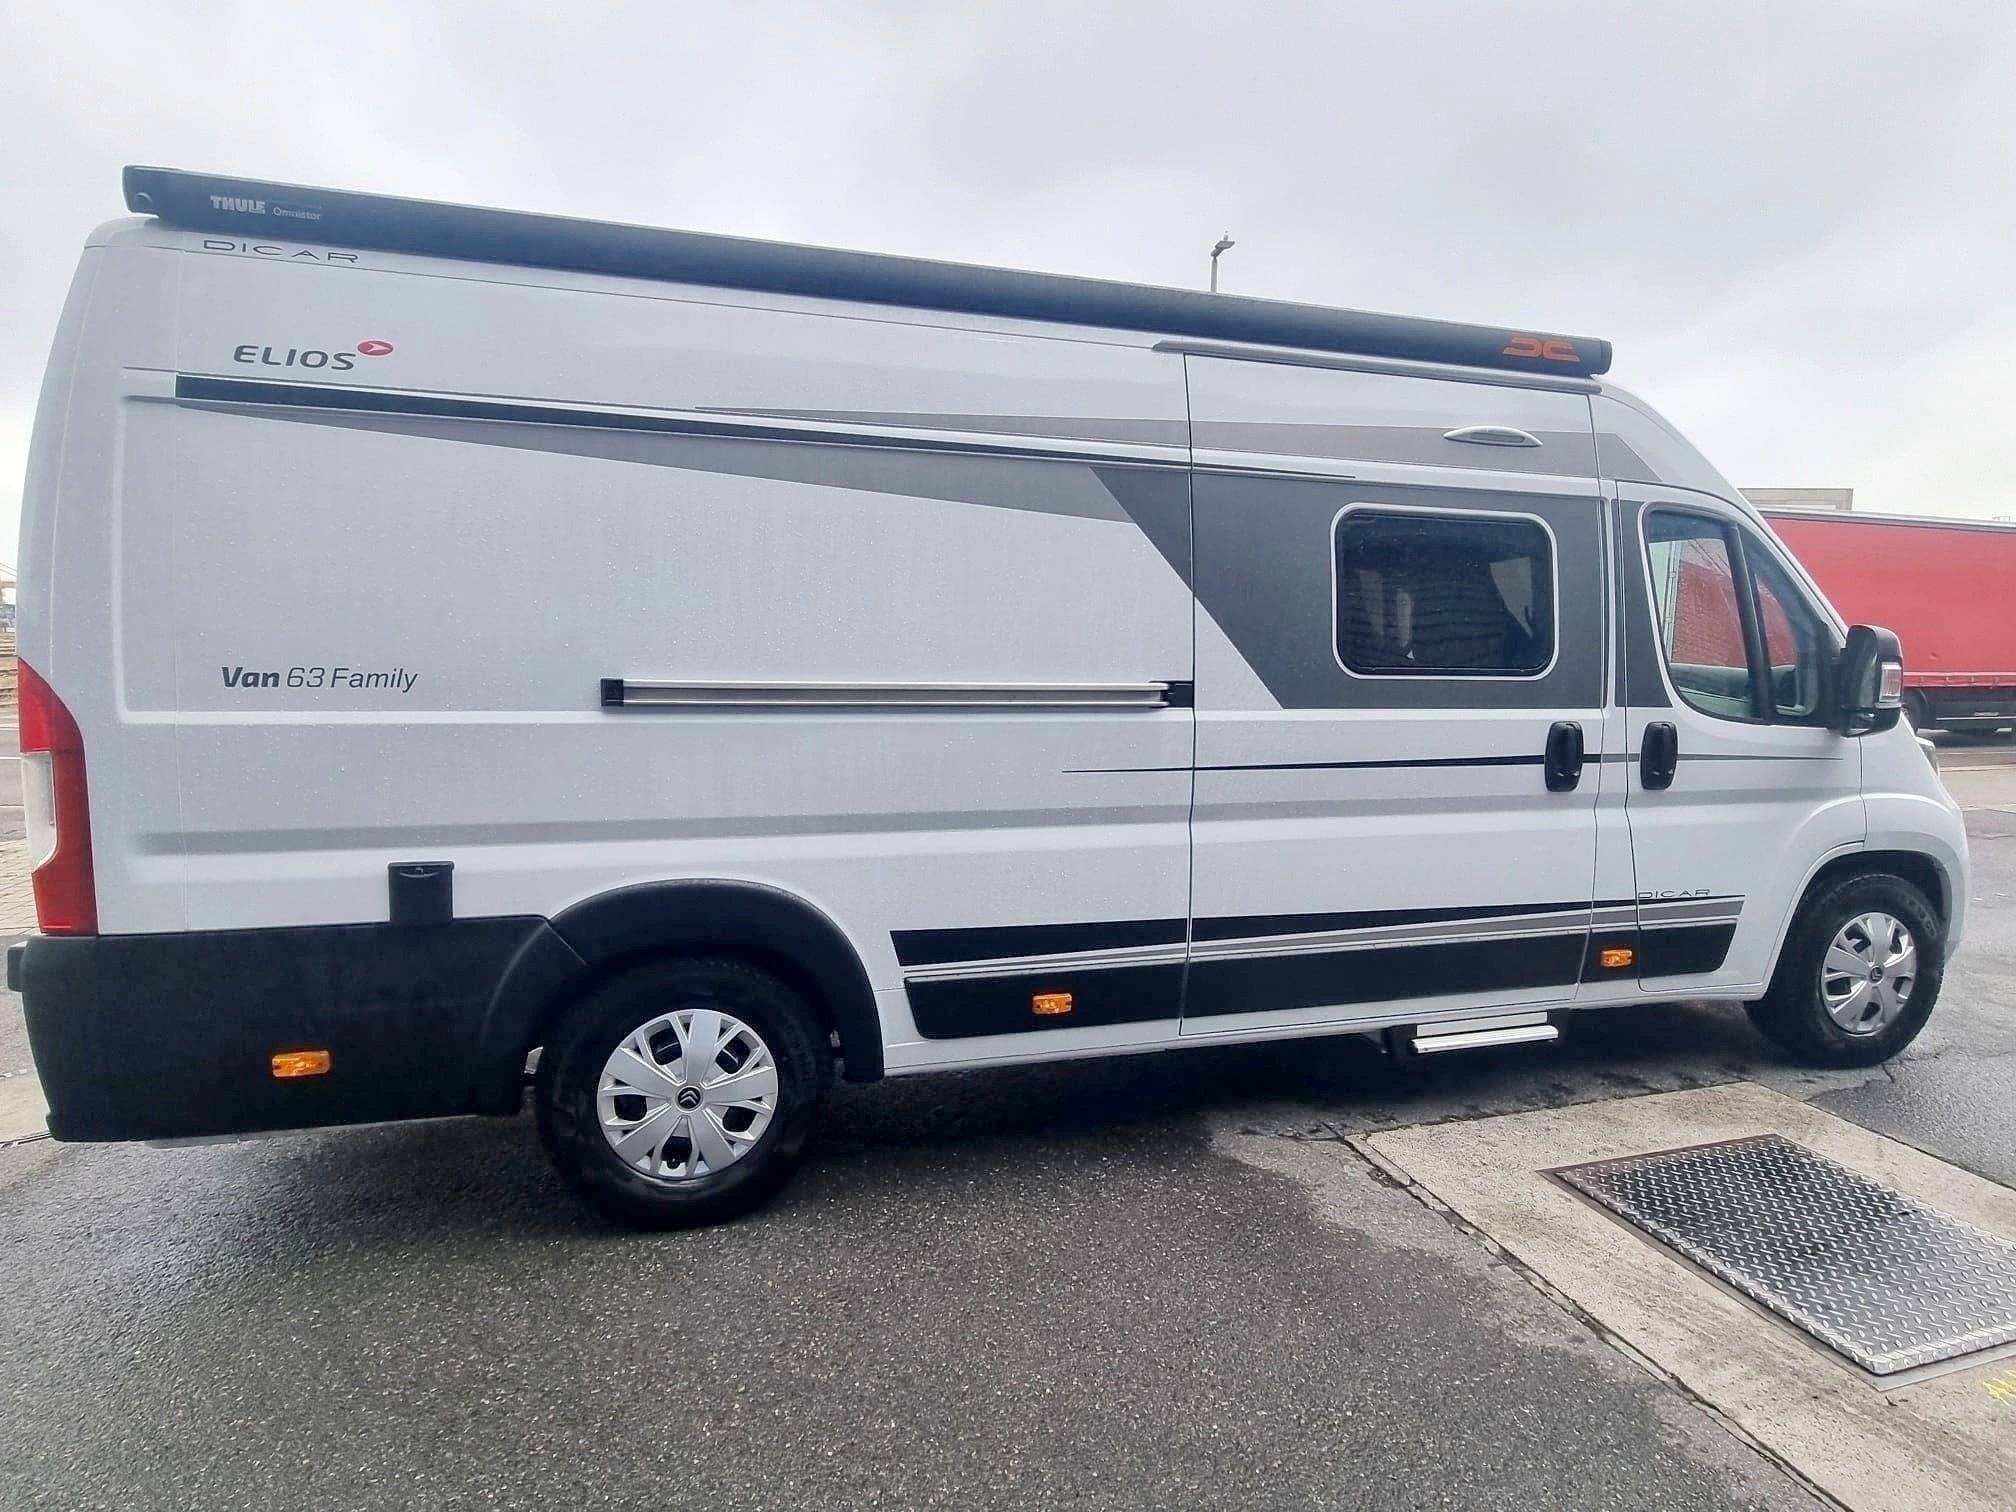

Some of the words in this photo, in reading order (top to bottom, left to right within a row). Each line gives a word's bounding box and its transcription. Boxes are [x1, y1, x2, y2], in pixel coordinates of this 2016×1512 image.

[210, 195, 266, 215] THULE
[203, 239, 358, 264] DICAR
[233, 344, 356, 371] ELIOS
[221, 666, 281, 689] Van
[286, 667, 326, 689] 63
[330, 667, 419, 694] Family
[1638, 888, 1711, 899] DICAR
